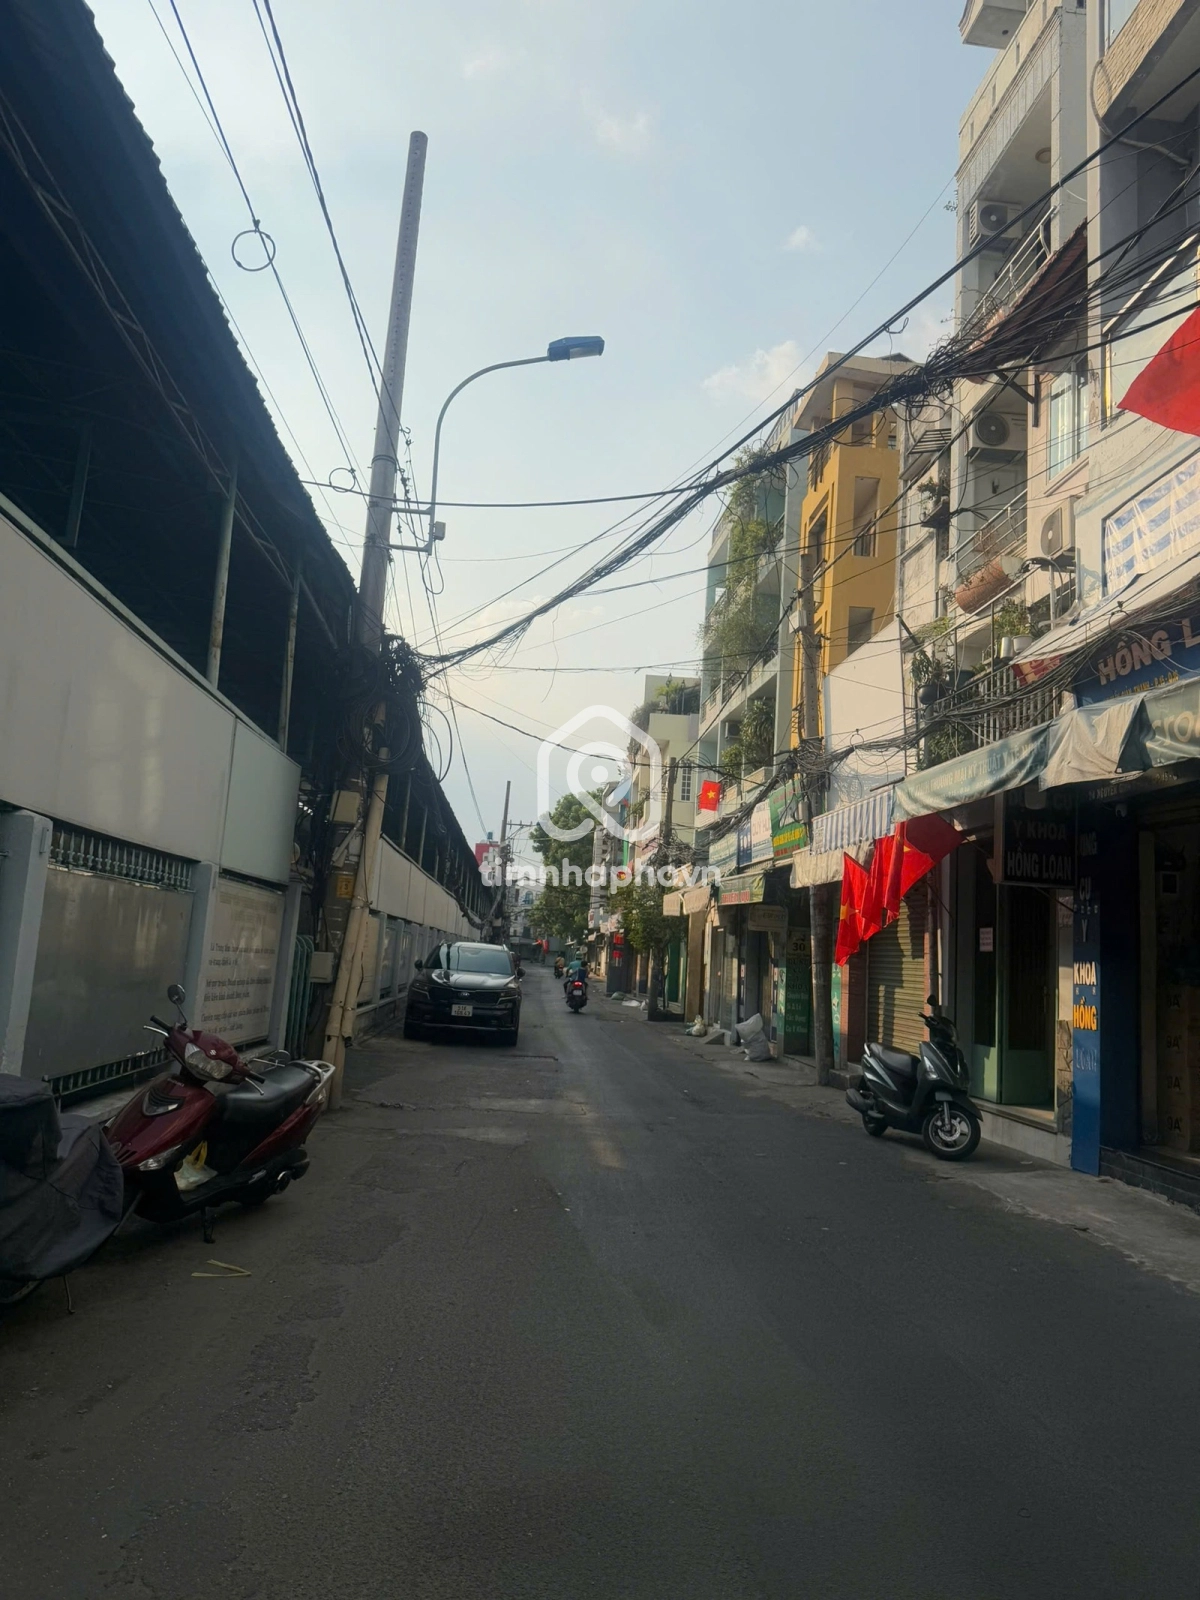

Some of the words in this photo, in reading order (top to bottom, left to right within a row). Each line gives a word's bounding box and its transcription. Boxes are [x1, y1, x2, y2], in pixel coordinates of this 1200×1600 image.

[1097, 630, 1173, 686] HỒNG
[1013, 820, 1022, 838] Y
[1027, 820, 1067, 841] KHOA
[1007, 841, 1039, 878] HỒNG
[1042, 853, 1072, 880] LOAN
[1081, 919, 1088, 942] Y
[793, 943, 805, 952] 30
[1074, 961, 1097, 986] KHOA
[1073, 996, 1097, 1031] HỒNG
